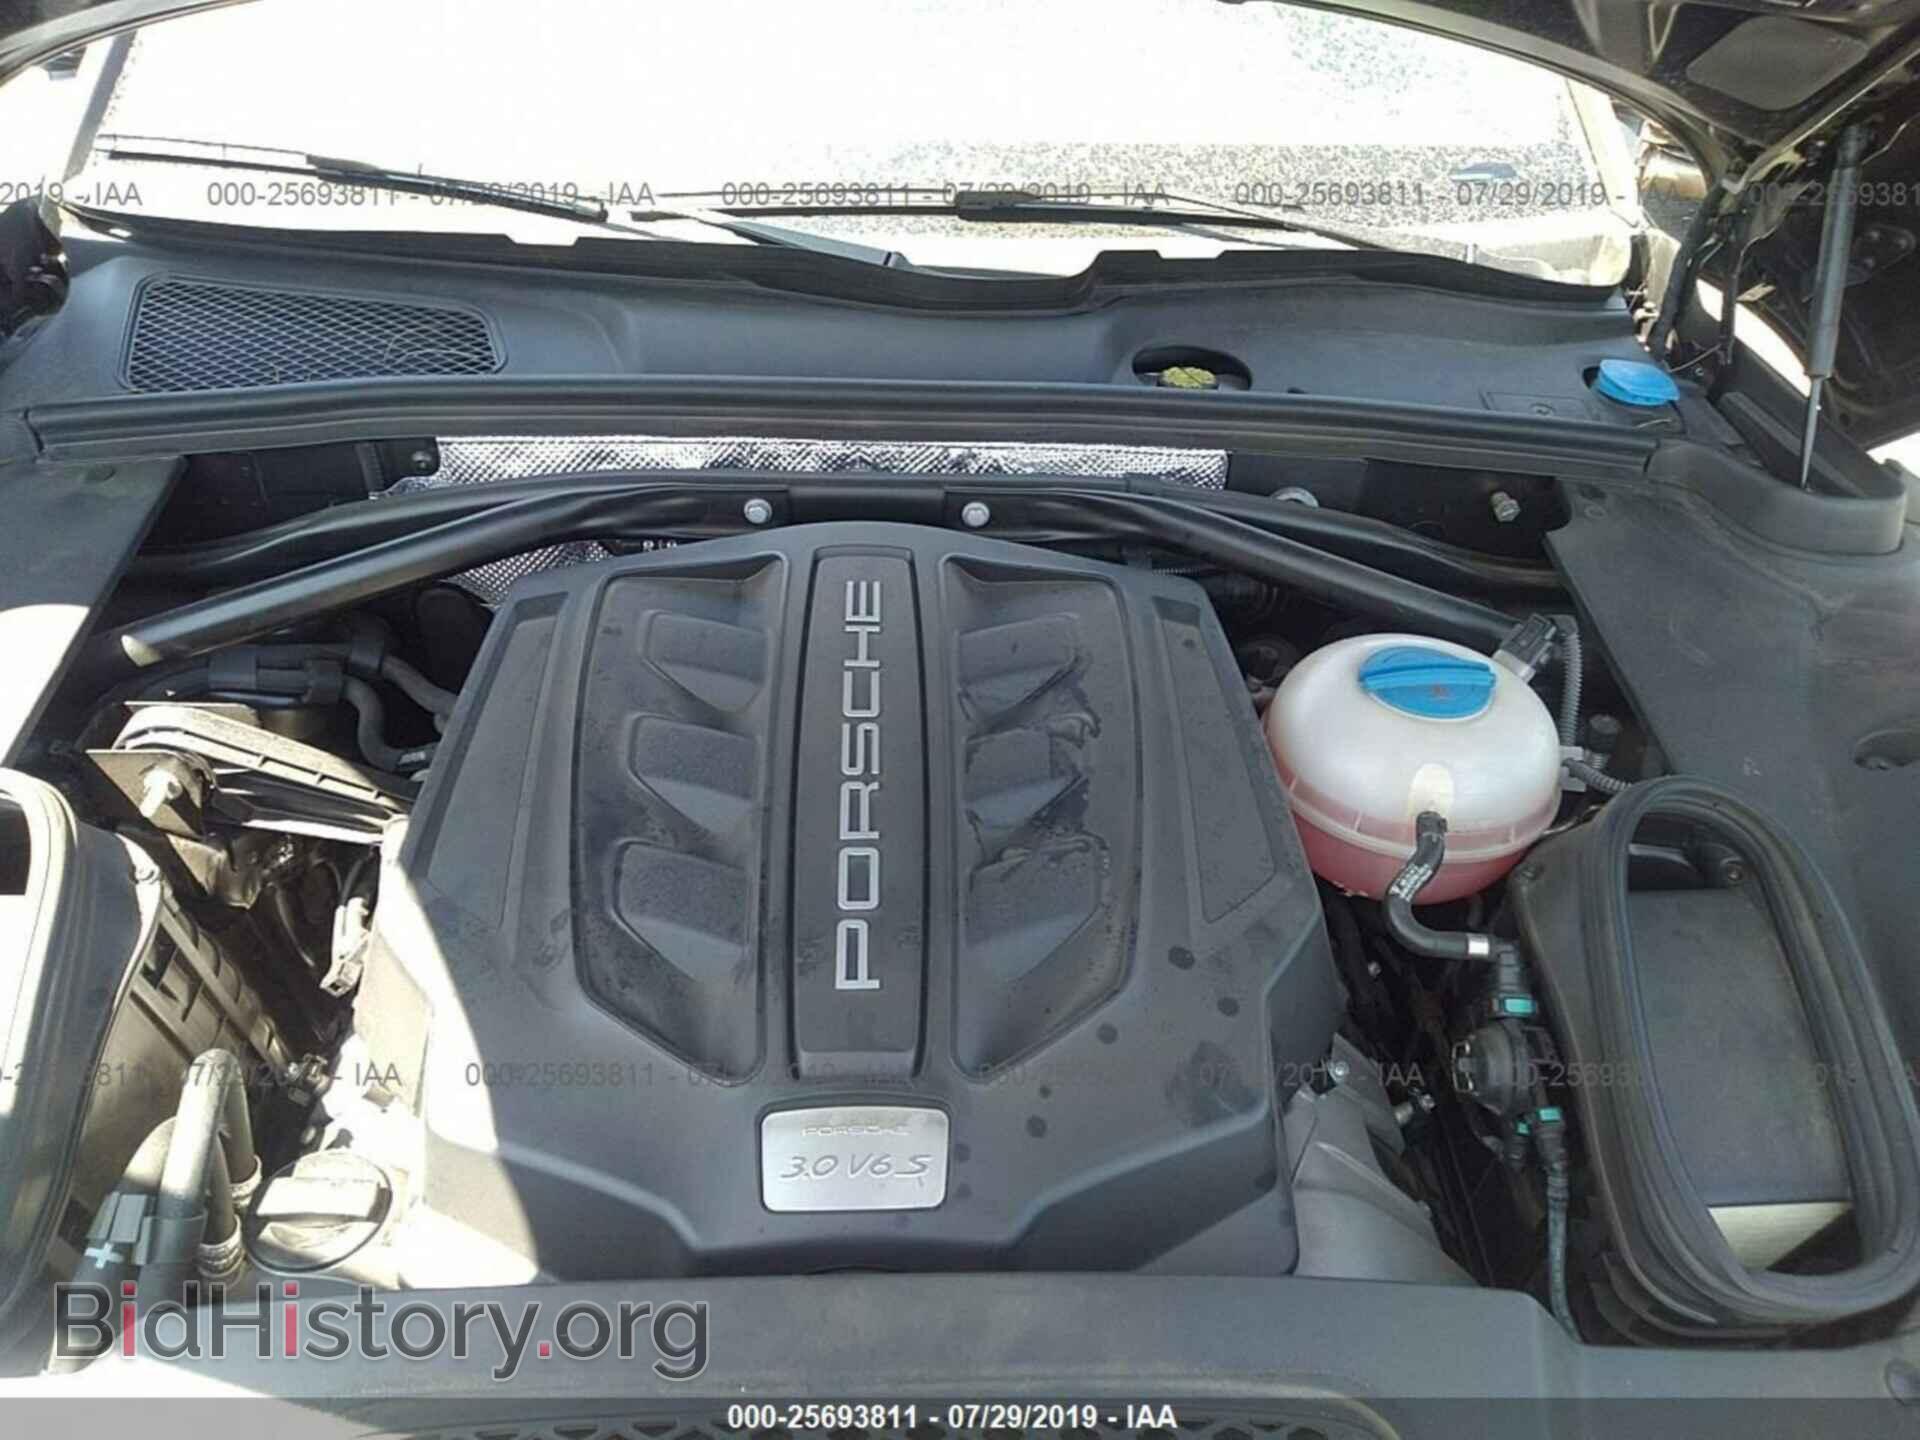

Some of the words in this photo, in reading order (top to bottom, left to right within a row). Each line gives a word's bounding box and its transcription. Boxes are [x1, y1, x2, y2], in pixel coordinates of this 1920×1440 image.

[835, 580, 881, 990] PORSCHE
[779, 1153, 838, 1179] 3.0
[848, 1152, 892, 1178] V6
[894, 1154, 933, 1177] S
